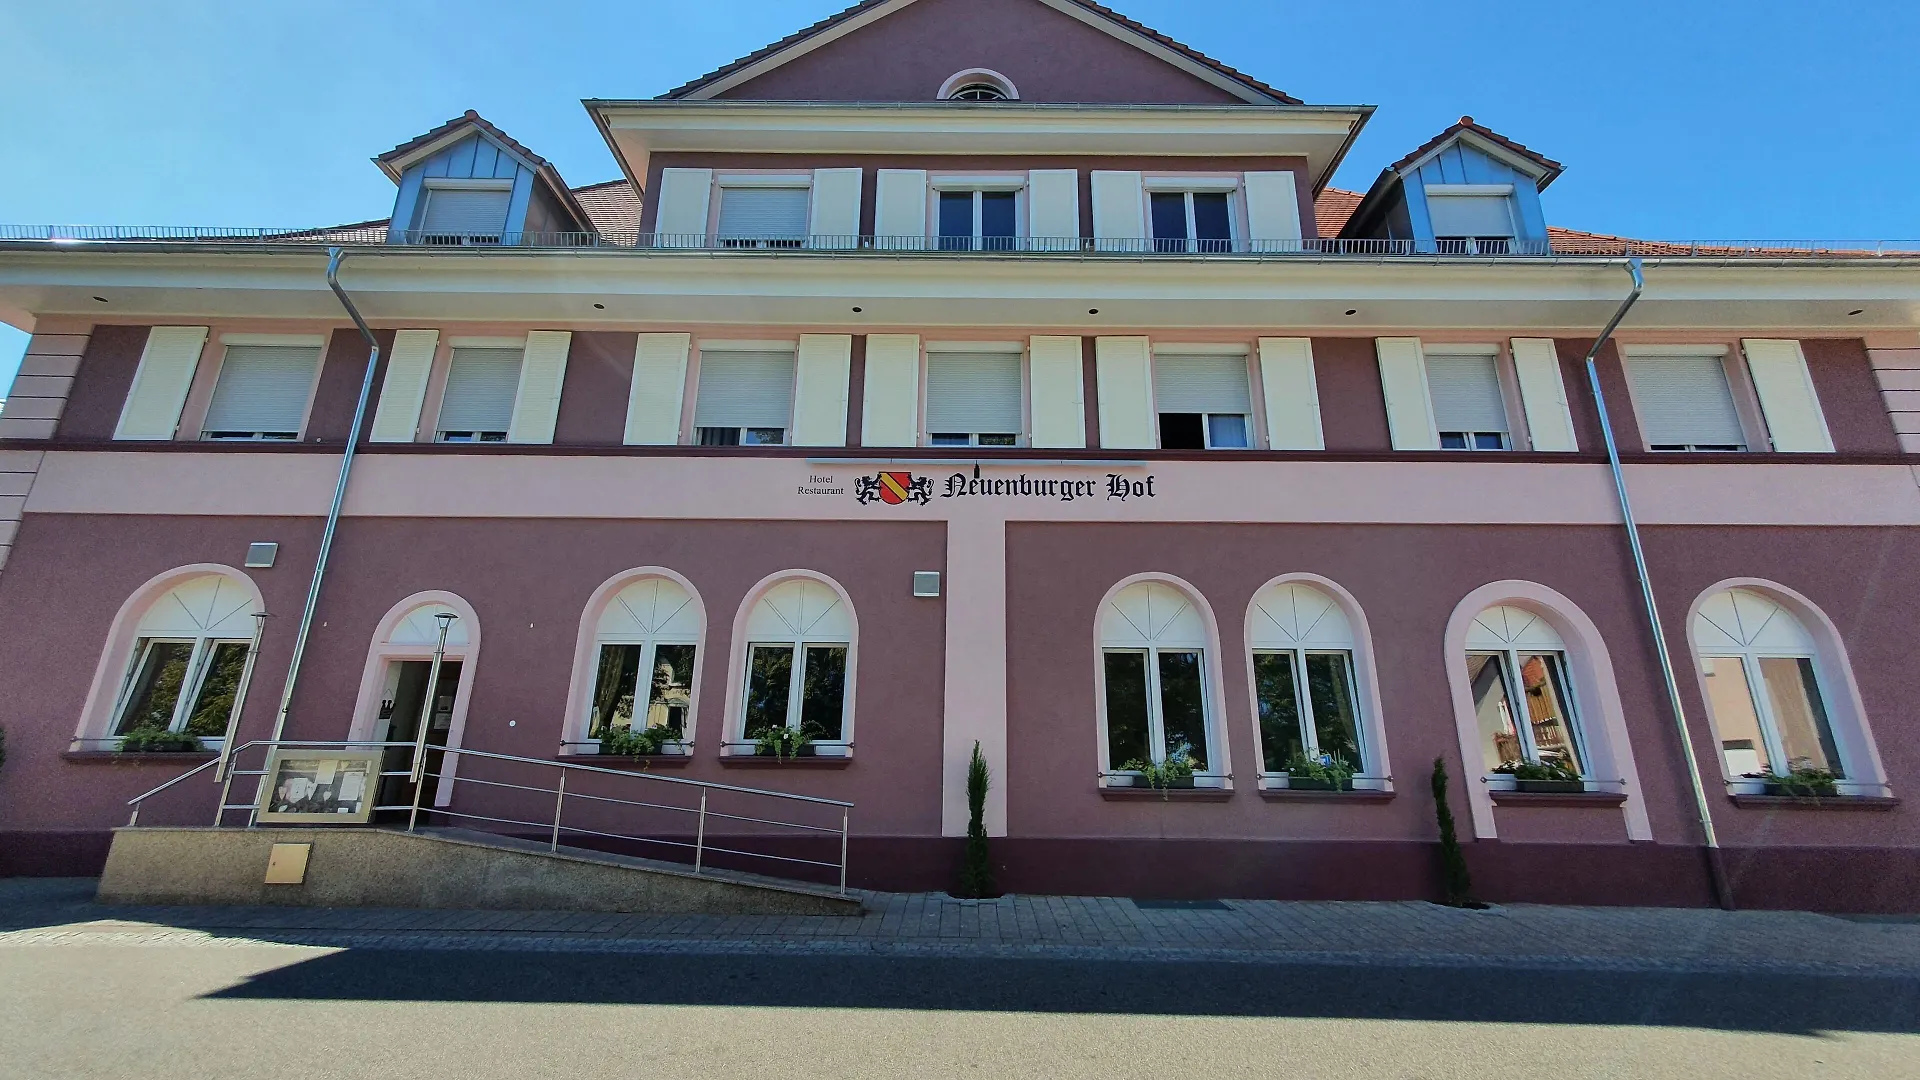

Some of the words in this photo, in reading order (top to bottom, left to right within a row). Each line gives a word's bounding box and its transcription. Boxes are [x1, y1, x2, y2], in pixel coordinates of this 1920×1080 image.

[809, 475, 833, 484] Hotel
[797, 486, 844, 495] Restaurant
[940, 473, 1096, 501] Neuenburger
[1105, 473, 1156, 501] Hof
